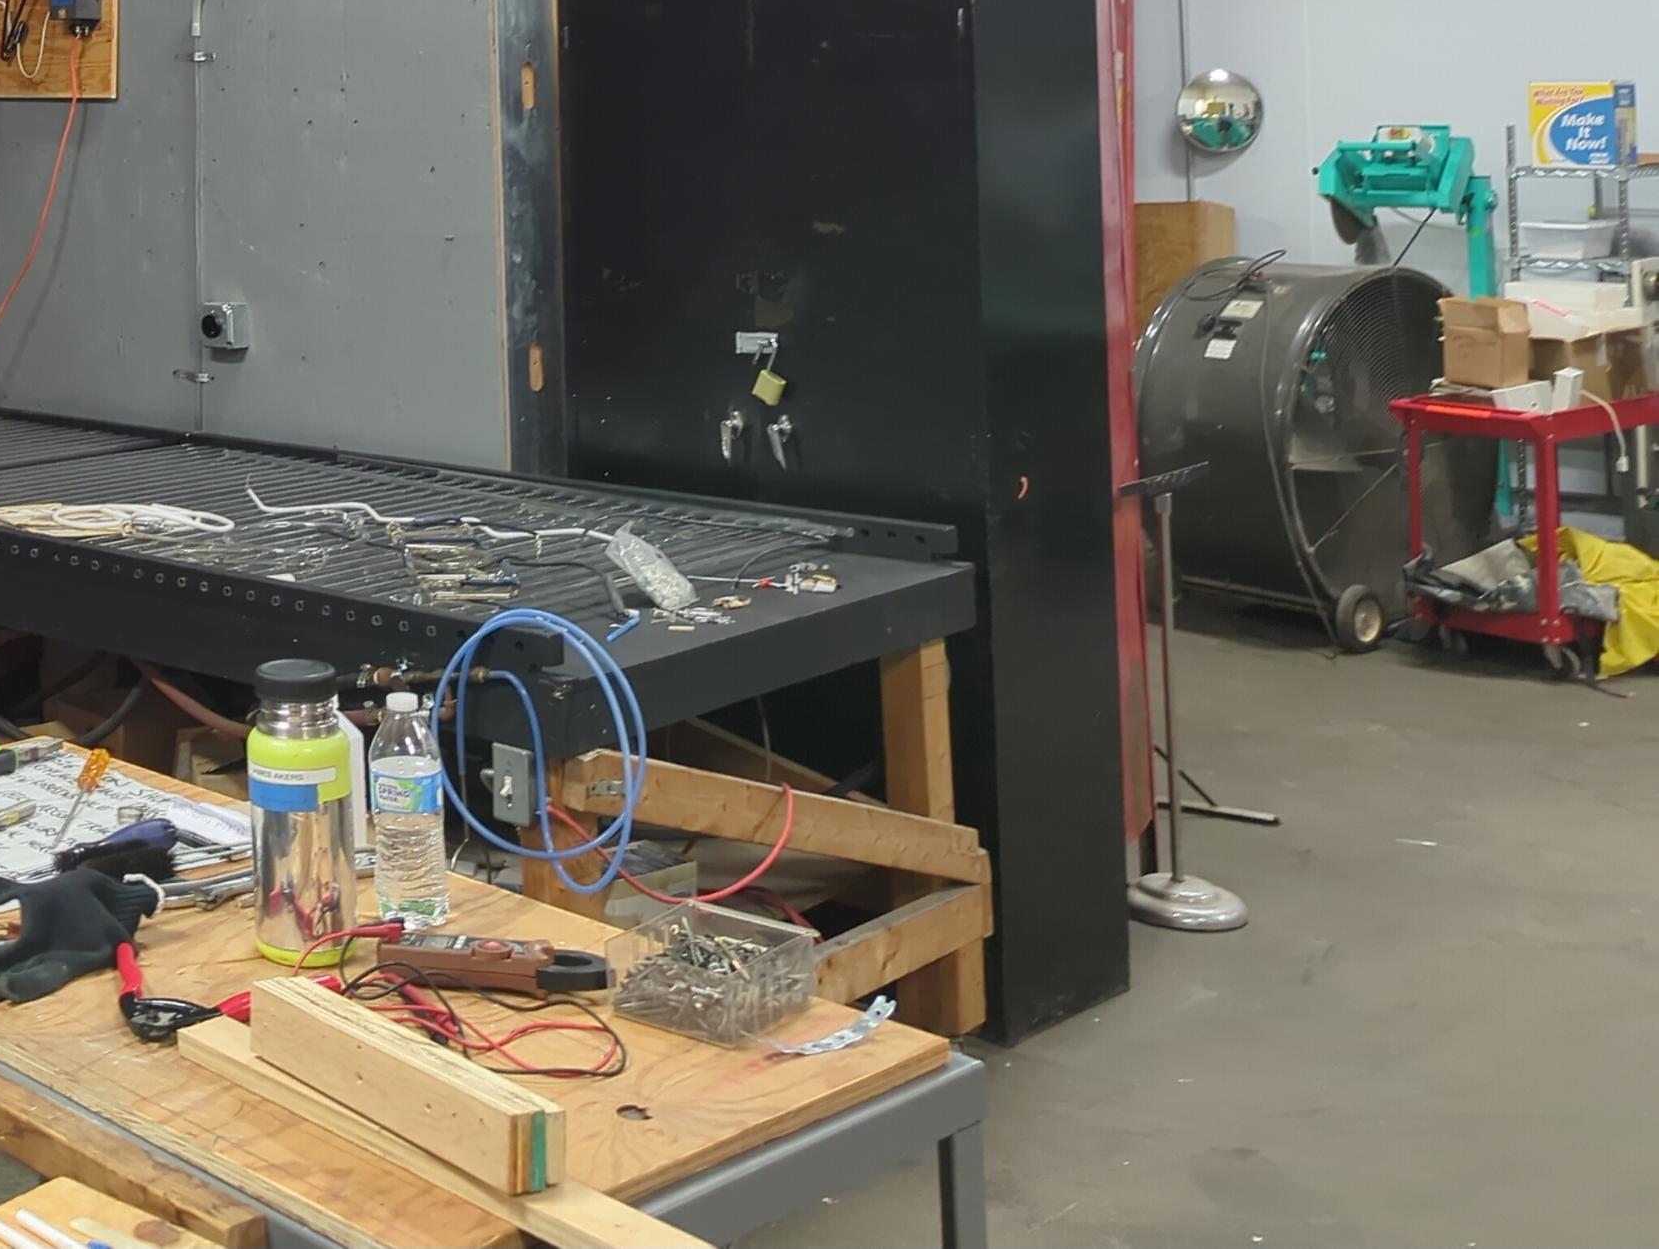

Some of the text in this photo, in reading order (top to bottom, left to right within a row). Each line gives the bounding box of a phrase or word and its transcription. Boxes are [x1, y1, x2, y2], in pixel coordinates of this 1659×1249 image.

[1560, 112, 1605, 127] Make
[1579, 126, 1592, 139] It
[1565, 136, 1608, 151] Now!
